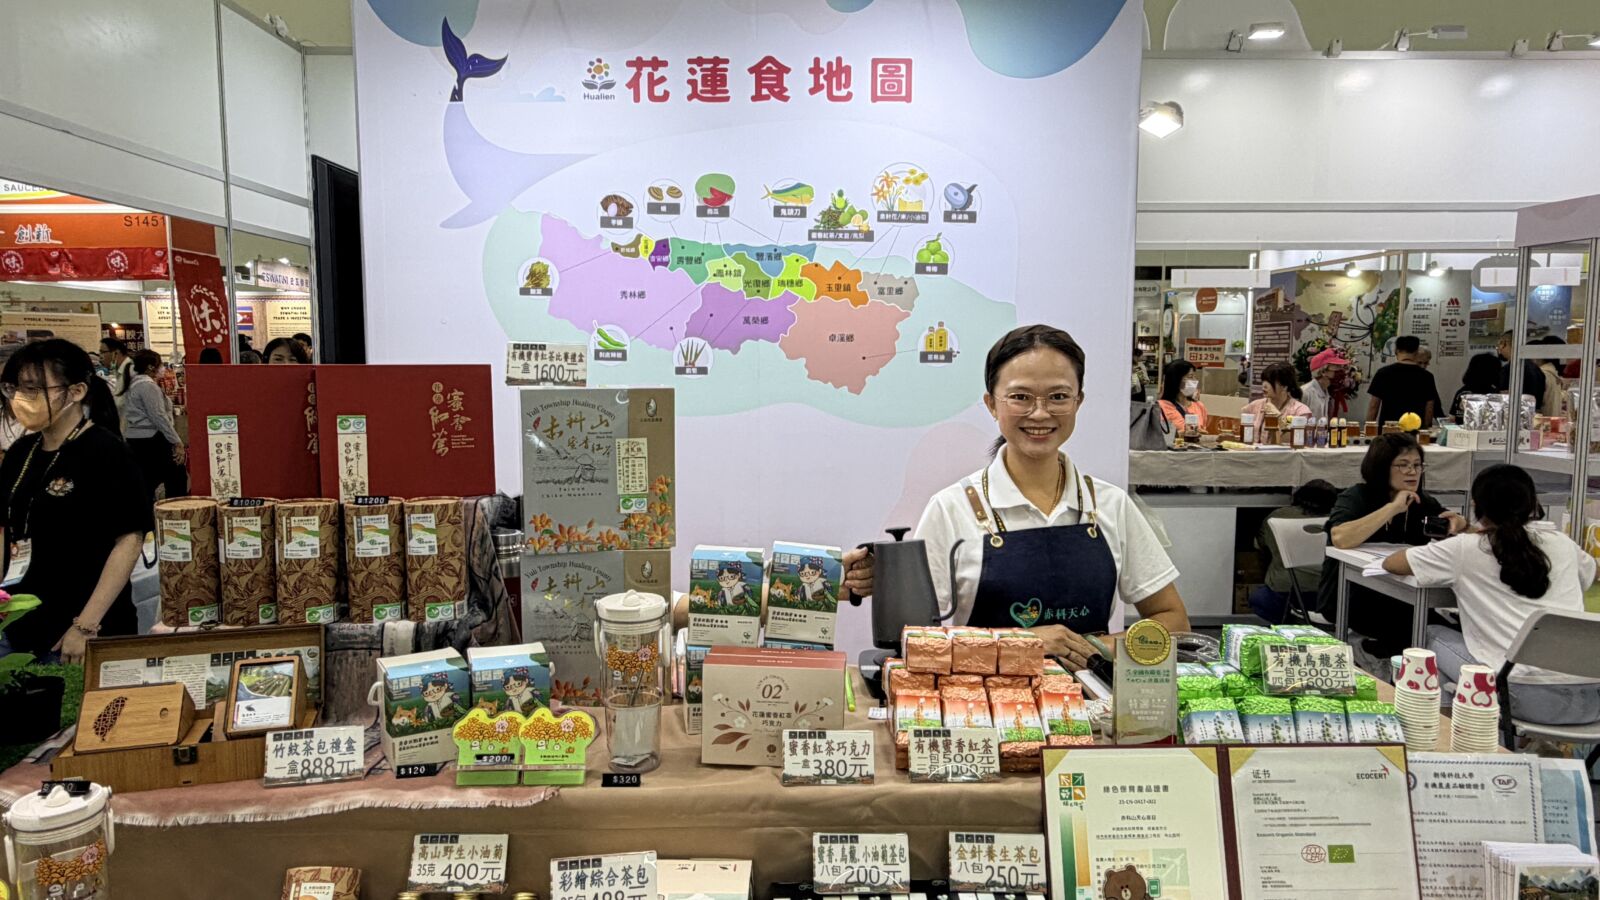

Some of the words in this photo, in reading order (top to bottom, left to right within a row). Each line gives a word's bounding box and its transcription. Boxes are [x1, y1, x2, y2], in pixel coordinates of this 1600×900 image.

[625, 55, 913, 104] 花蓮食地圖
[583, 92, 616, 101] Hualien
[780, 208, 800, 216] 鬼頭刀
[826, 283, 852, 292] 玉里鎮
[877, 287, 904, 296] 富里鄉
[619, 290, 646, 299] 秀林鄉
[742, 316, 769, 325] 萬榮鄉
[828, 334, 855, 343] 卓溪鄉
[540, 399, 571, 412] Township
[537, 560, 568, 572] Township
[1043, 605, 1090, 620] 赤科天心
[1273, 652, 1347, 668] 有機烏龍茶
[1273, 667, 1349, 678] 一包600元
[761, 683, 783, 699] 02
[752, 710, 793, 719] 花蓮蜜香紅茶
[761, 719, 782, 727] 巧克力
[273, 736, 357, 758] 竹紋茶包禮盒
[789, 739, 871, 757] 蜜香紅茶巧克力
[914, 738, 994, 754] 有機蜜香紅茶
[917, 753, 996, 764] 一包500元
[274, 753, 356, 779] 一盒888元
[400, 765, 426, 775] $120
[791, 757, 869, 777] 一盒380元
[612, 775, 638, 784] $320
[1356, 772, 1388, 780] ECOCERT
[418, 843, 504, 861] 高山野生小油菊
[955, 843, 1041, 864] 金針養生茶包
[416, 863, 436, 877] 35克
[440, 860, 502, 880] 400元
[957, 862, 1040, 890] 八包250元
[559, 863, 649, 892] 彩繪綜合茶包
